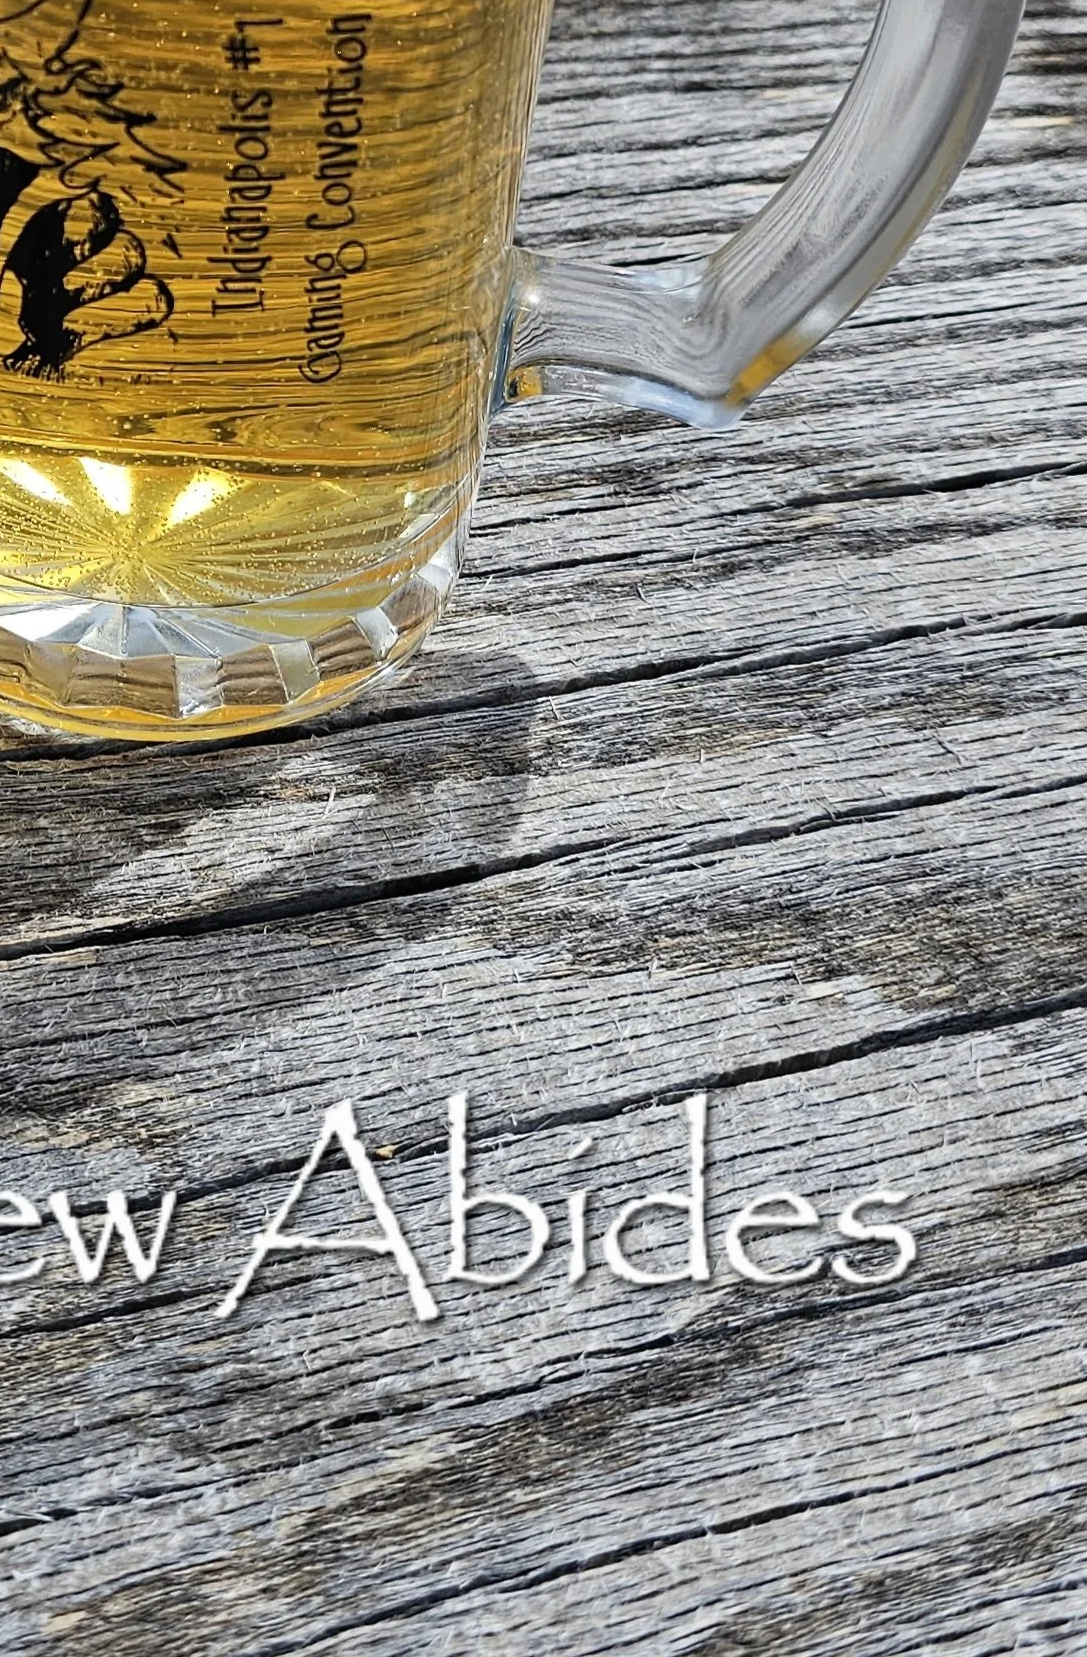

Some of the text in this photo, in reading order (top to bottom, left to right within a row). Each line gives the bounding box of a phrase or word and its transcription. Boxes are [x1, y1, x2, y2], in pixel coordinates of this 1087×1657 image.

[210, 15, 284, 318] Indianapolis #1
[304, 11, 373, 231] Convention
[298, 240, 369, 385] Gaming
